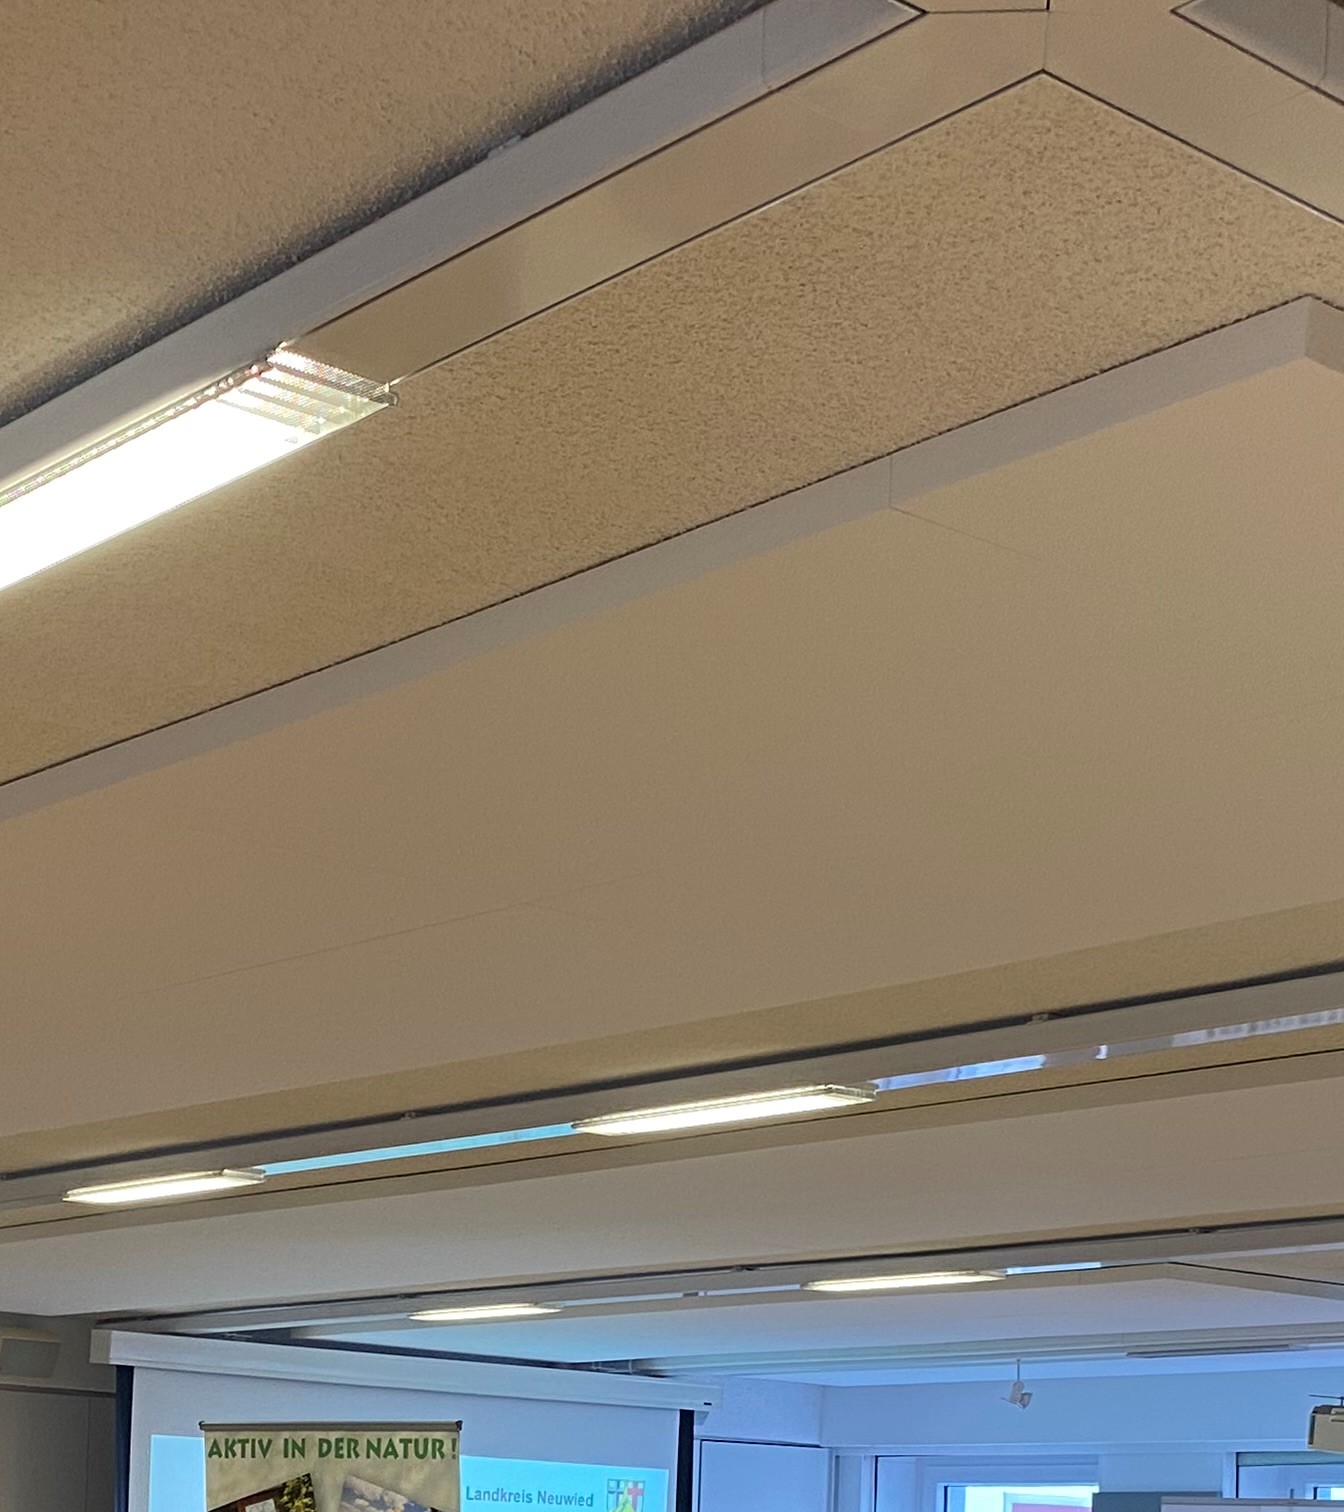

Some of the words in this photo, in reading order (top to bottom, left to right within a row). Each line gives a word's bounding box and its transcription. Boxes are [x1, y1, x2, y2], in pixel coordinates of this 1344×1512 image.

[207, 1437, 273, 1459] AKTIV
[283, 1437, 306, 1459] IN
[317, 1437, 360, 1459] DER
[465, 1486, 533, 1504] Landkreis
[537, 1490, 594, 1508] Neuwied
